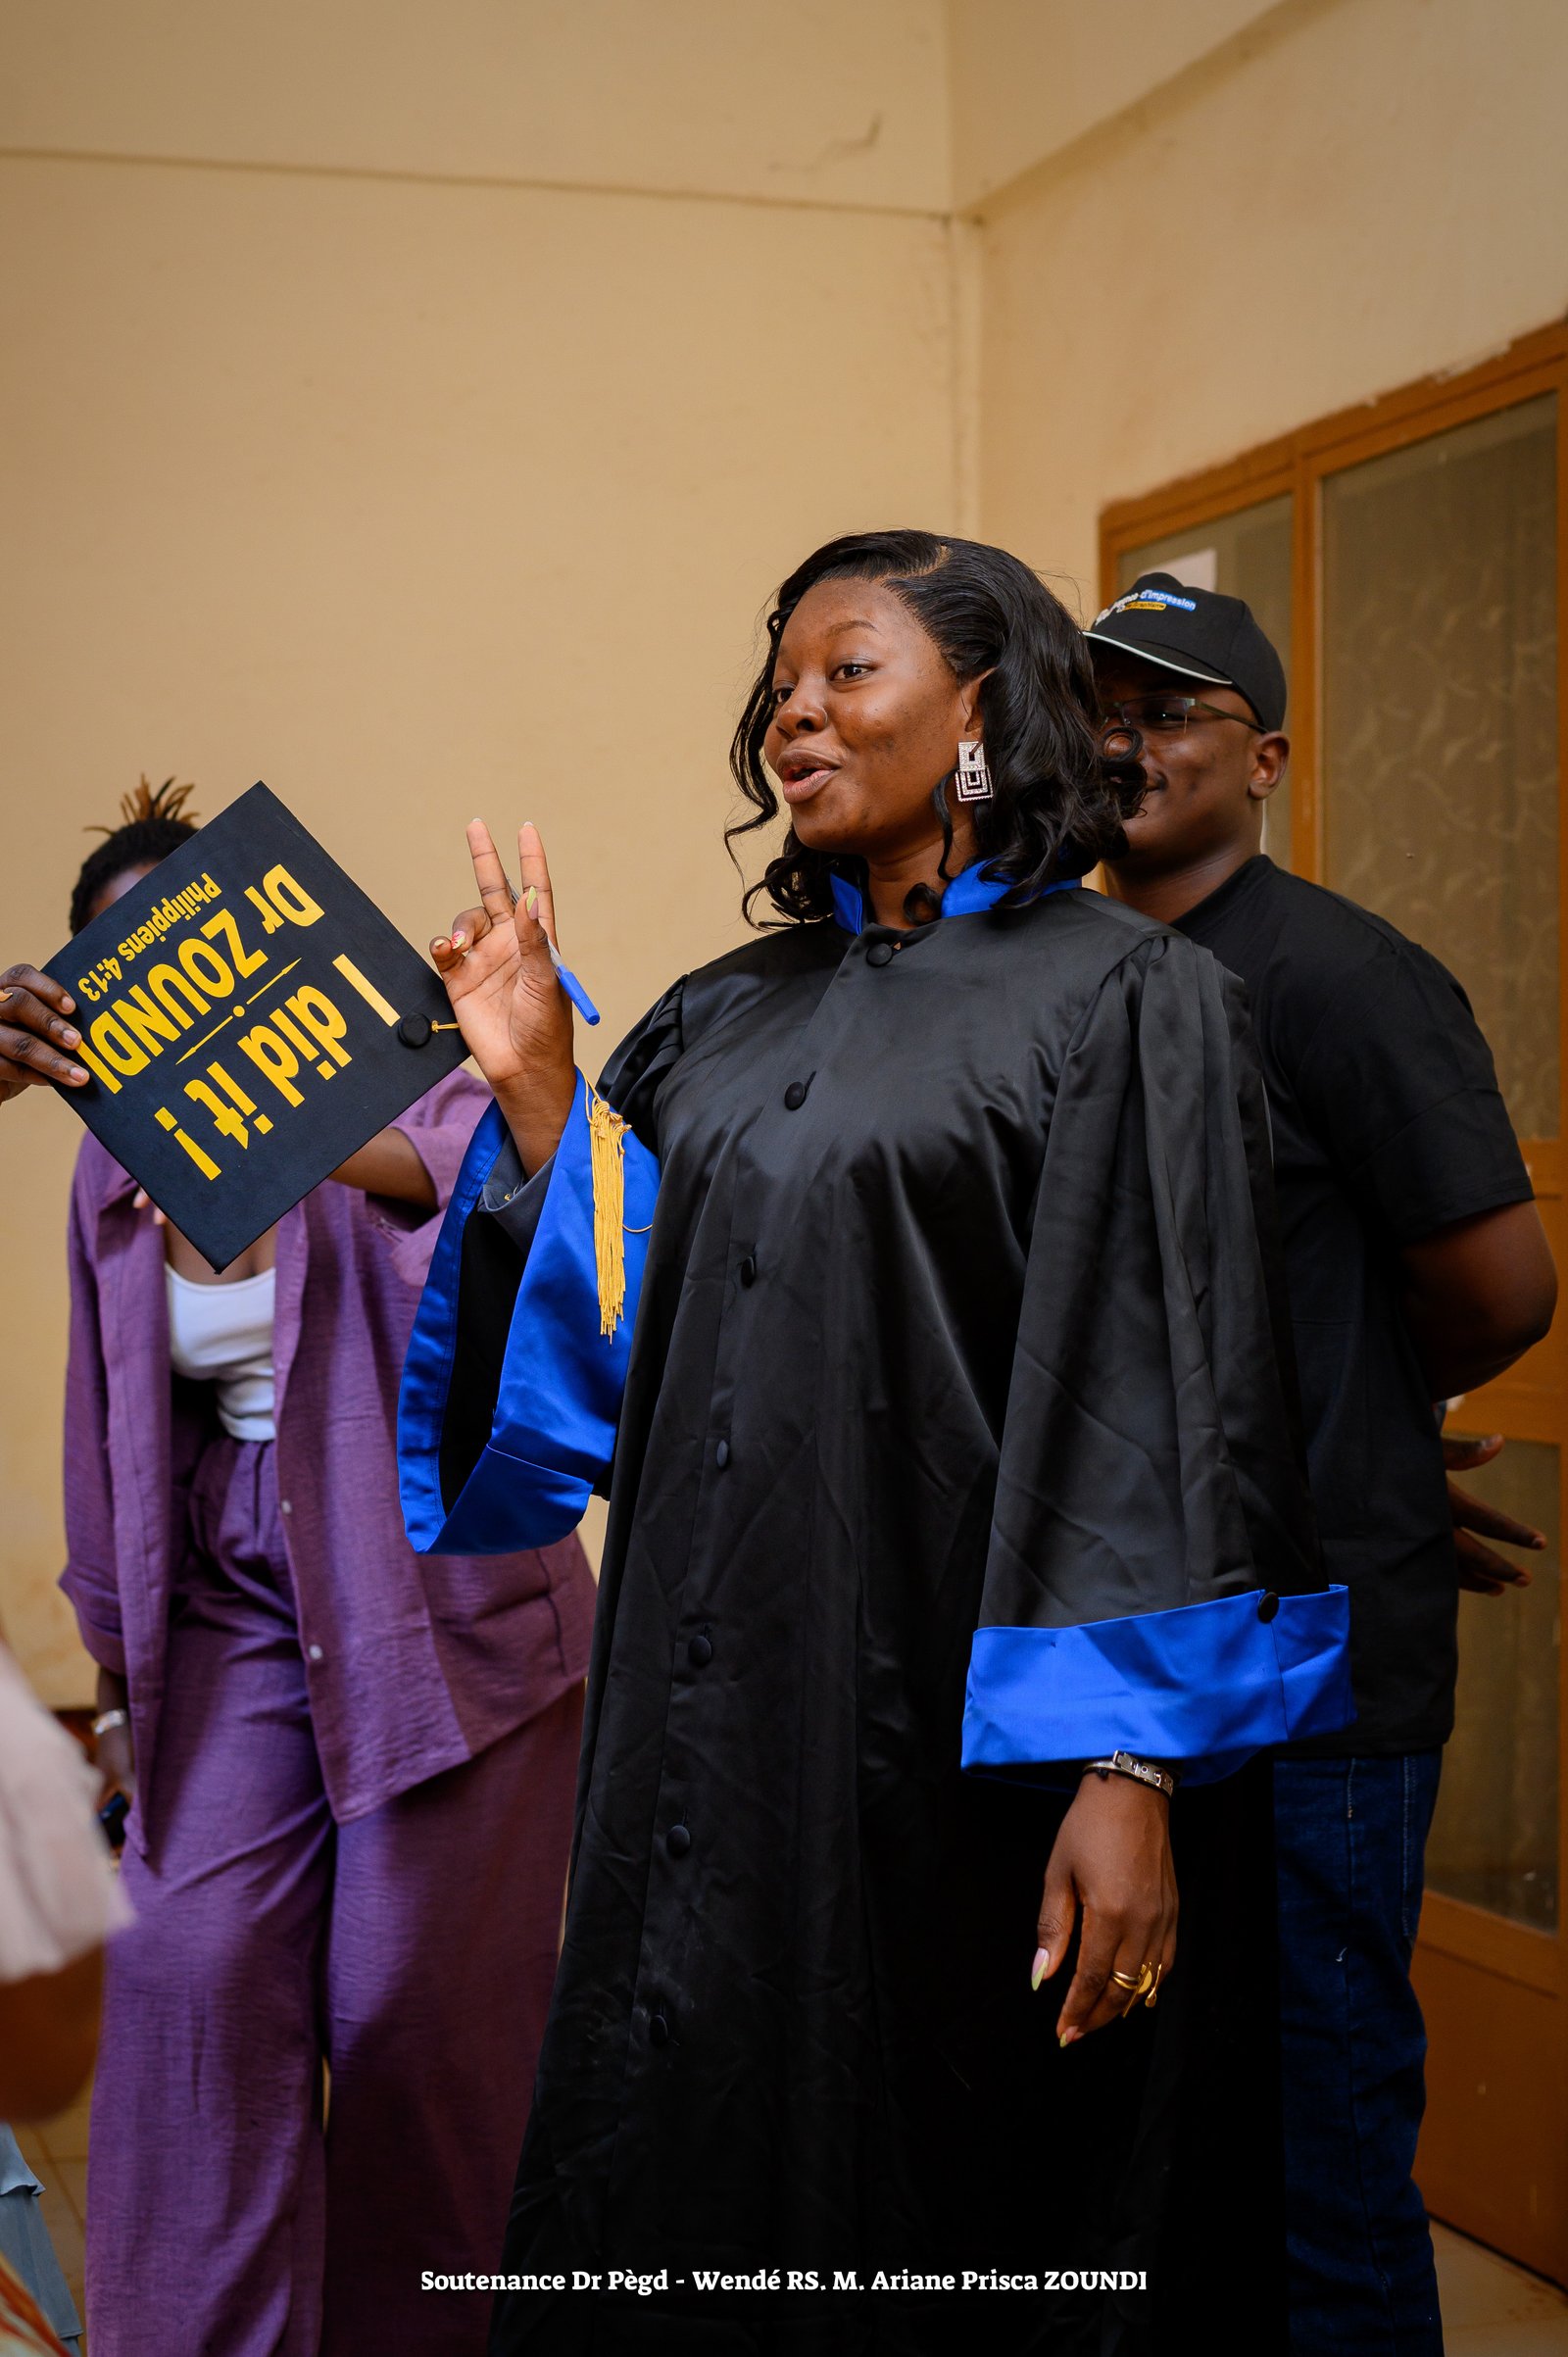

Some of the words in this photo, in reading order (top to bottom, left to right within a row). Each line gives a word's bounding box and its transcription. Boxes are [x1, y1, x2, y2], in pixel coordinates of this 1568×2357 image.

[117, 872, 222, 962] Philippiens
[244, 863, 324, 934] Dr
[76, 908, 269, 1095] ZOUNDI
[77, 957, 123, 1002] 4:13
[333, 954, 400, 1026] I
[237, 986, 352, 1107] did
